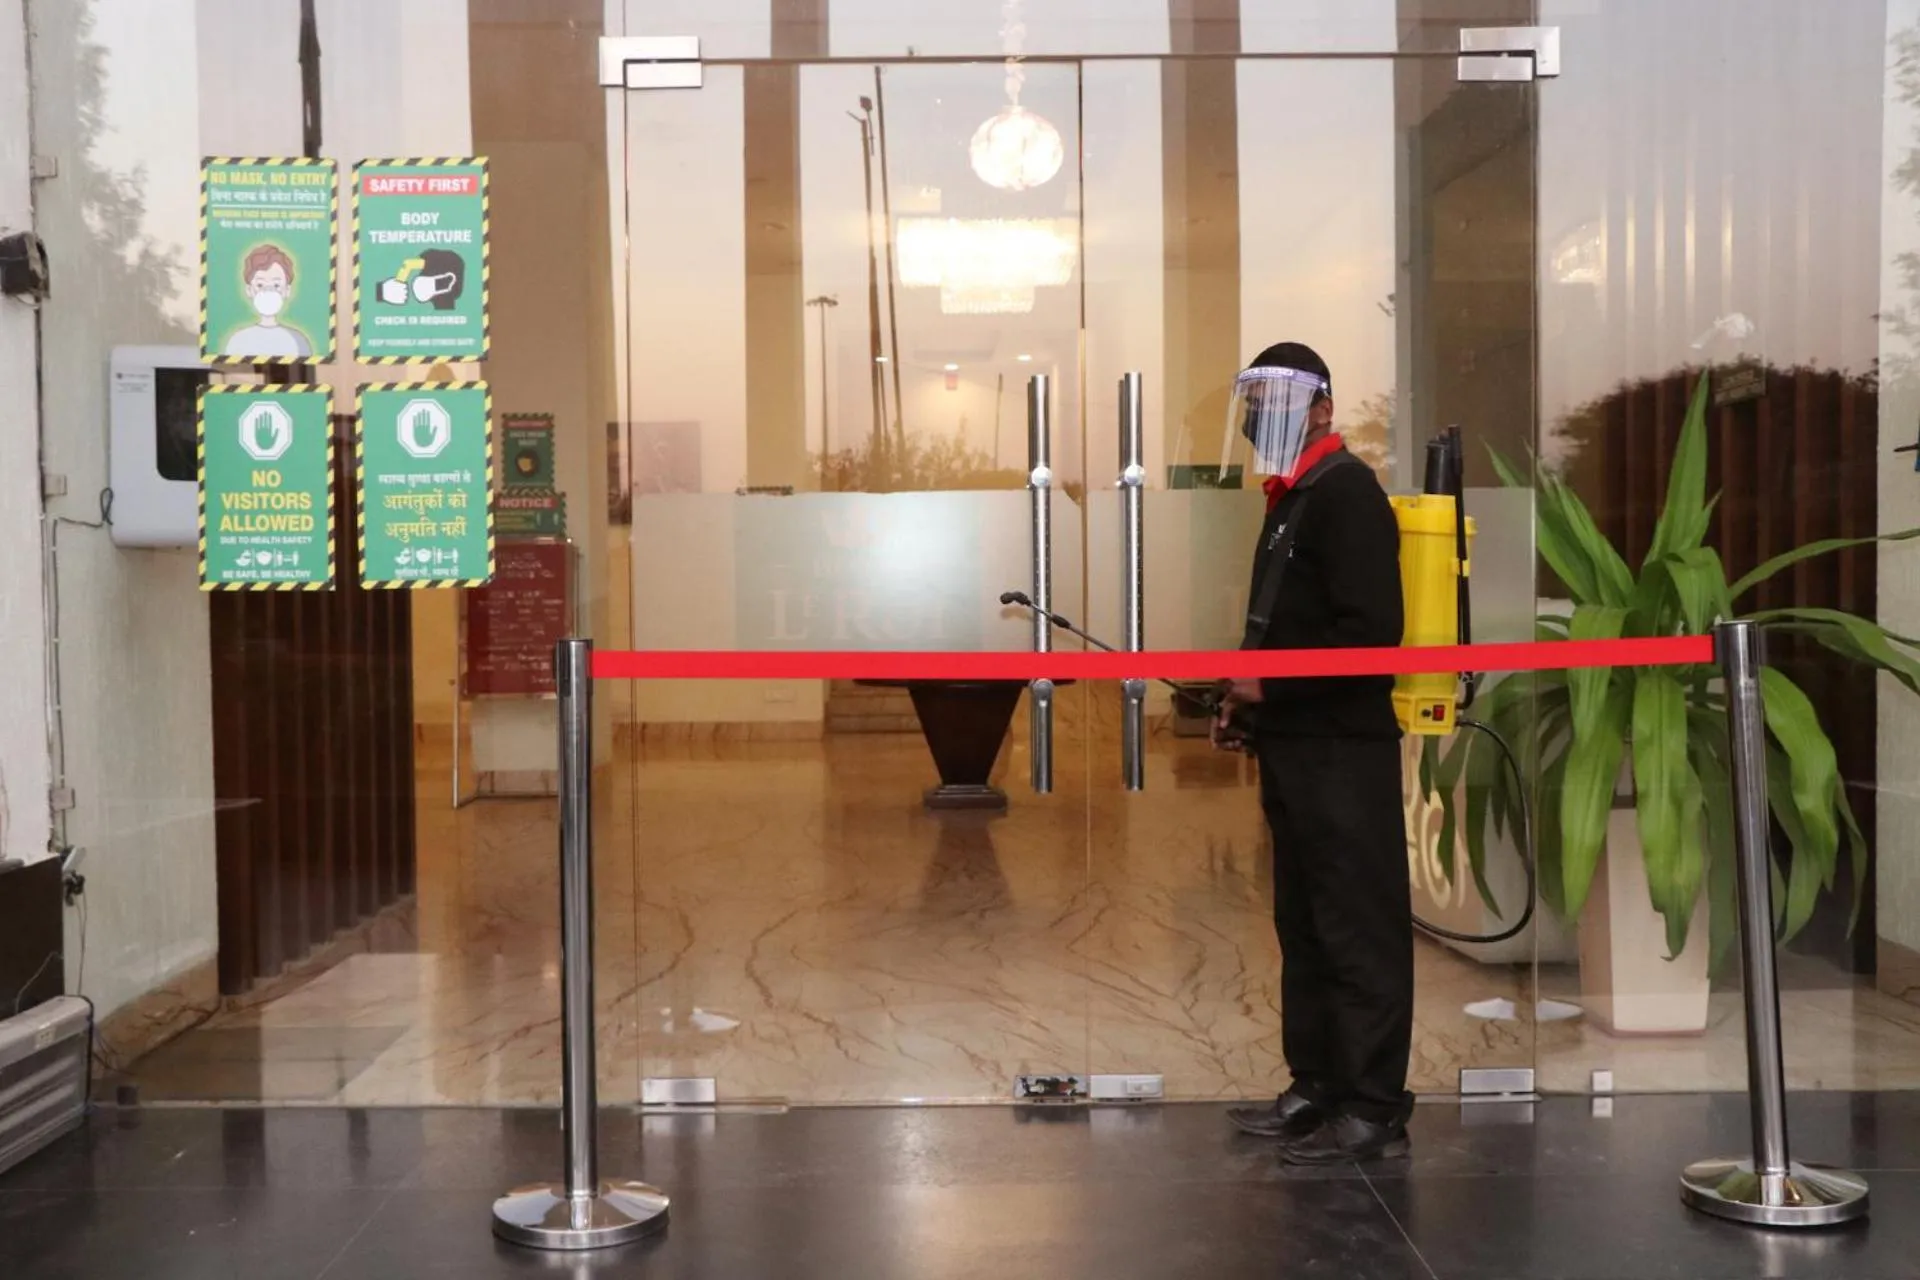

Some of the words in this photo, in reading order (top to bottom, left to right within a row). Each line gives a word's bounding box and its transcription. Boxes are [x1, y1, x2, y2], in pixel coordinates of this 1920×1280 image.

[210, 172, 227, 185] NO
[270, 172, 287, 185] NO
[290, 172, 328, 186] ENTRY
[368, 178, 425, 193] SAFETY
[427, 178, 471, 193] FIRST
[399, 211, 440, 226] BODY
[367, 229, 473, 244] TEMPERATURE
[374, 315, 406, 326] CHECK
[420, 315, 468, 327] REQUIRED
[251, 469, 282, 488] NO
[220, 491, 313, 511] VISITORS
[382, 487, 445, 515] आगंतुकों
[447, 487, 469, 510] को
[499, 497, 552, 509] NOTICE
[219, 514, 315, 533] ALLOWED
[384, 515, 438, 543] अनुमति
[440, 515, 469, 541] नहीं
